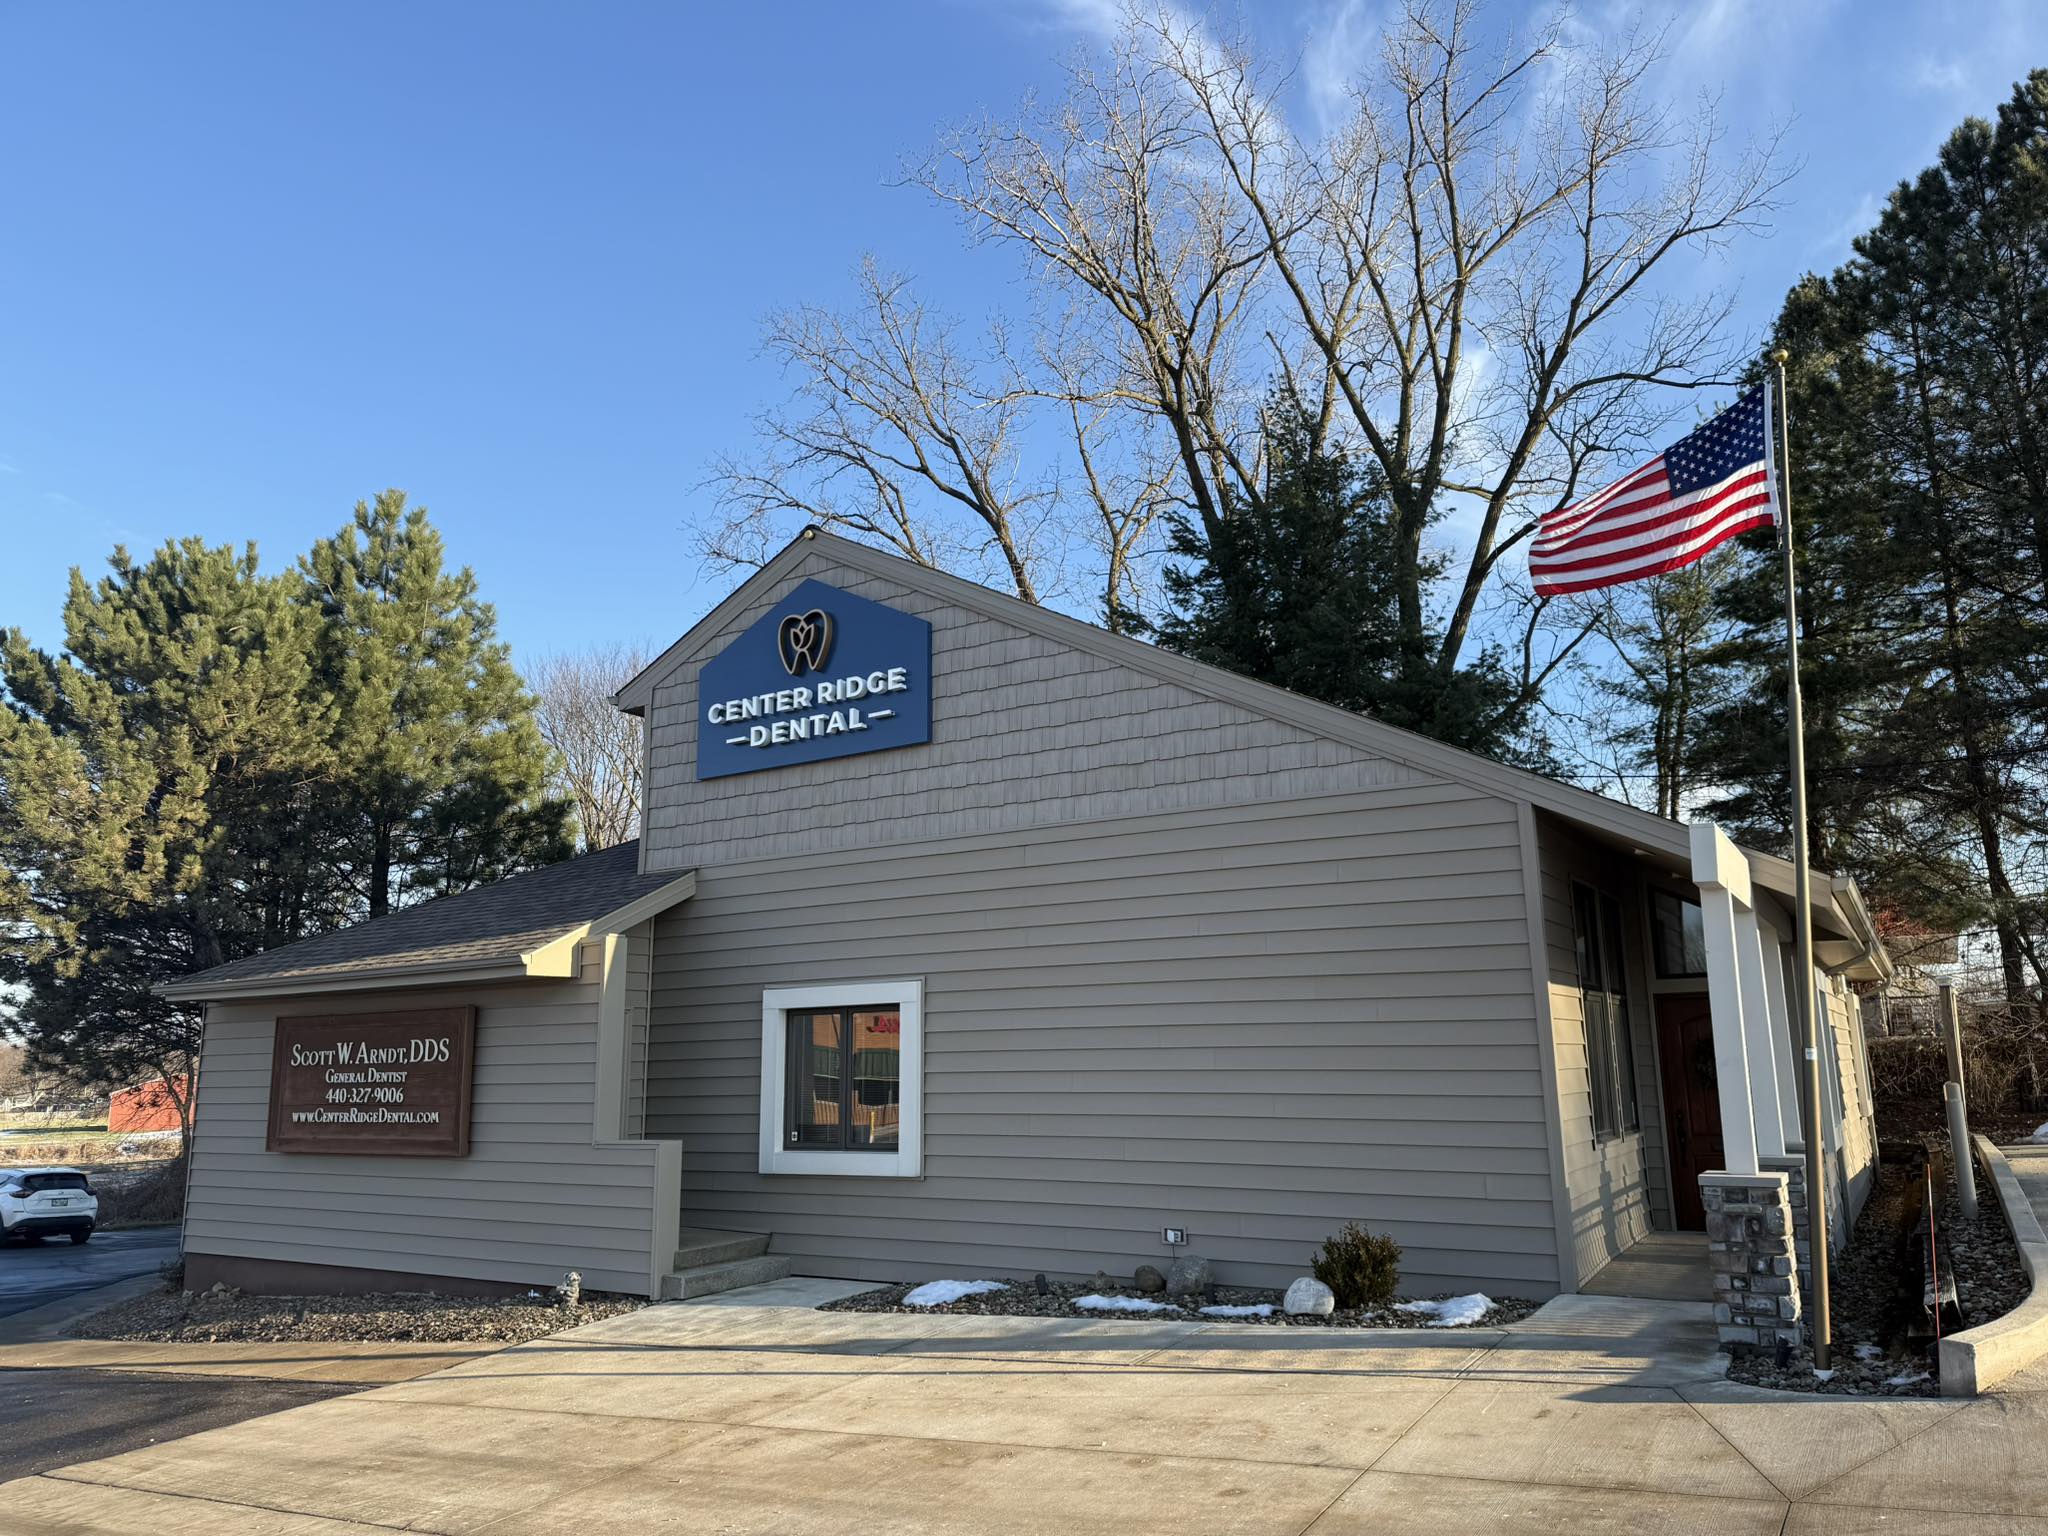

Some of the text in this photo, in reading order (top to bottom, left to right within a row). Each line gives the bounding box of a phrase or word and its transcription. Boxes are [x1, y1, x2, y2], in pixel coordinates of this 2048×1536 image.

[707, 667, 907, 724] CENTER RIDGE
[750, 707, 867, 747] DENTAL
[336, 1042, 353, 1064] W.
[409, 1037, 450, 1062] DDS
